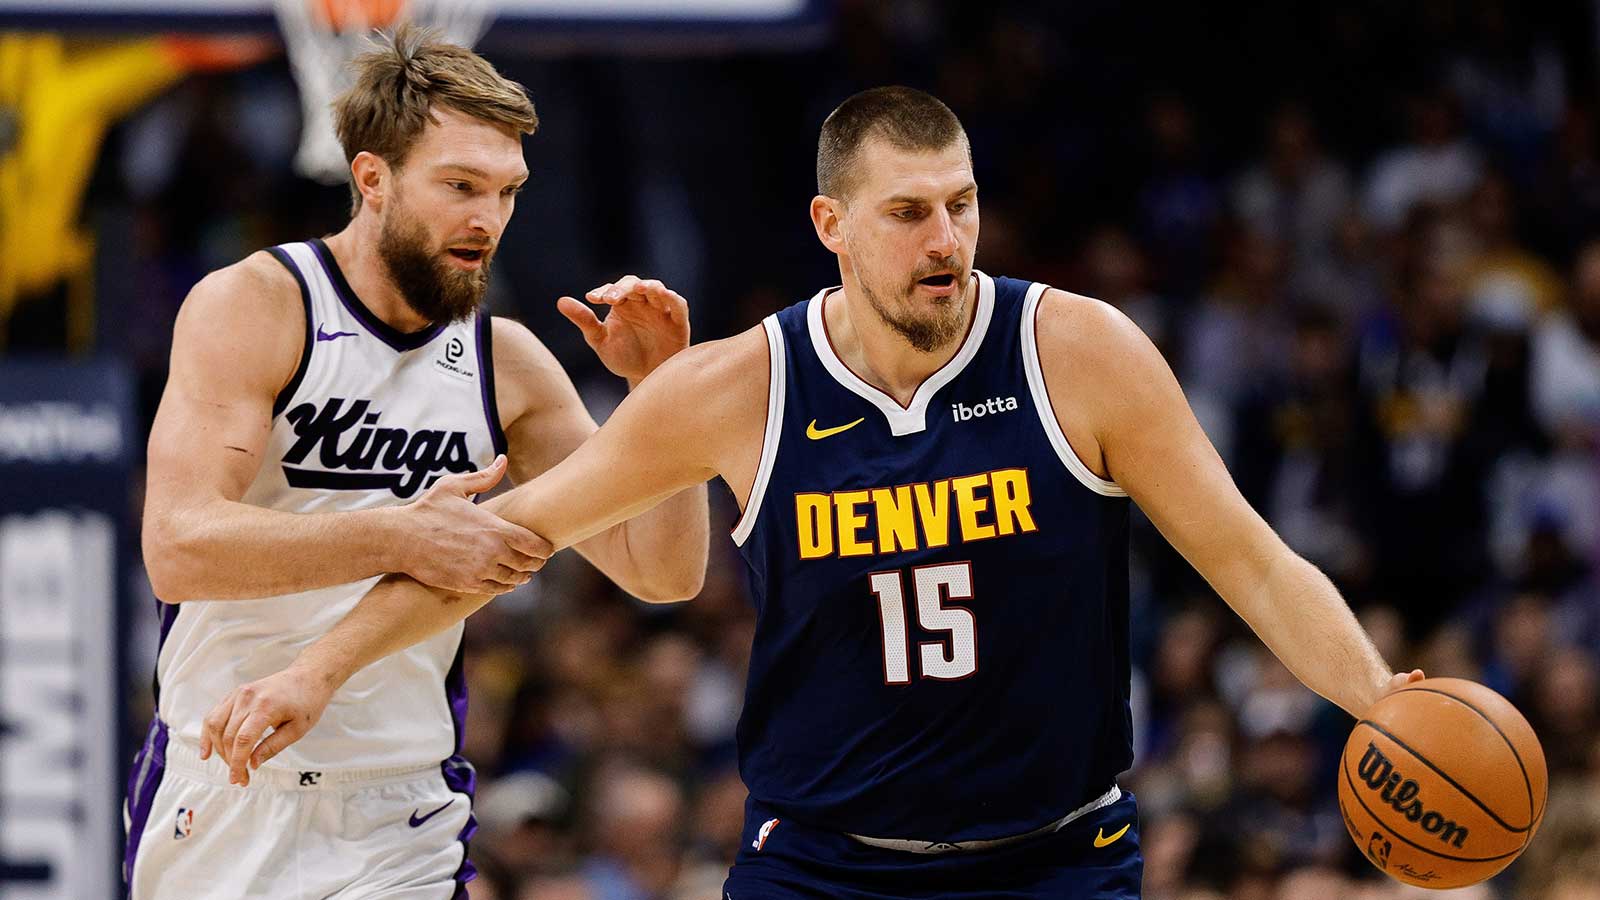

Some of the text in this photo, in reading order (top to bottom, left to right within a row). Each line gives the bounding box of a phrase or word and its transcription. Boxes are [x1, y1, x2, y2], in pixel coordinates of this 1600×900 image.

[281, 398, 478, 499] Kings
[952, 396, 1018, 422] ibotta
[794, 467, 1038, 560] DENVER
[867, 560, 979, 685] 15
[1358, 740, 1470, 850] Wilson
